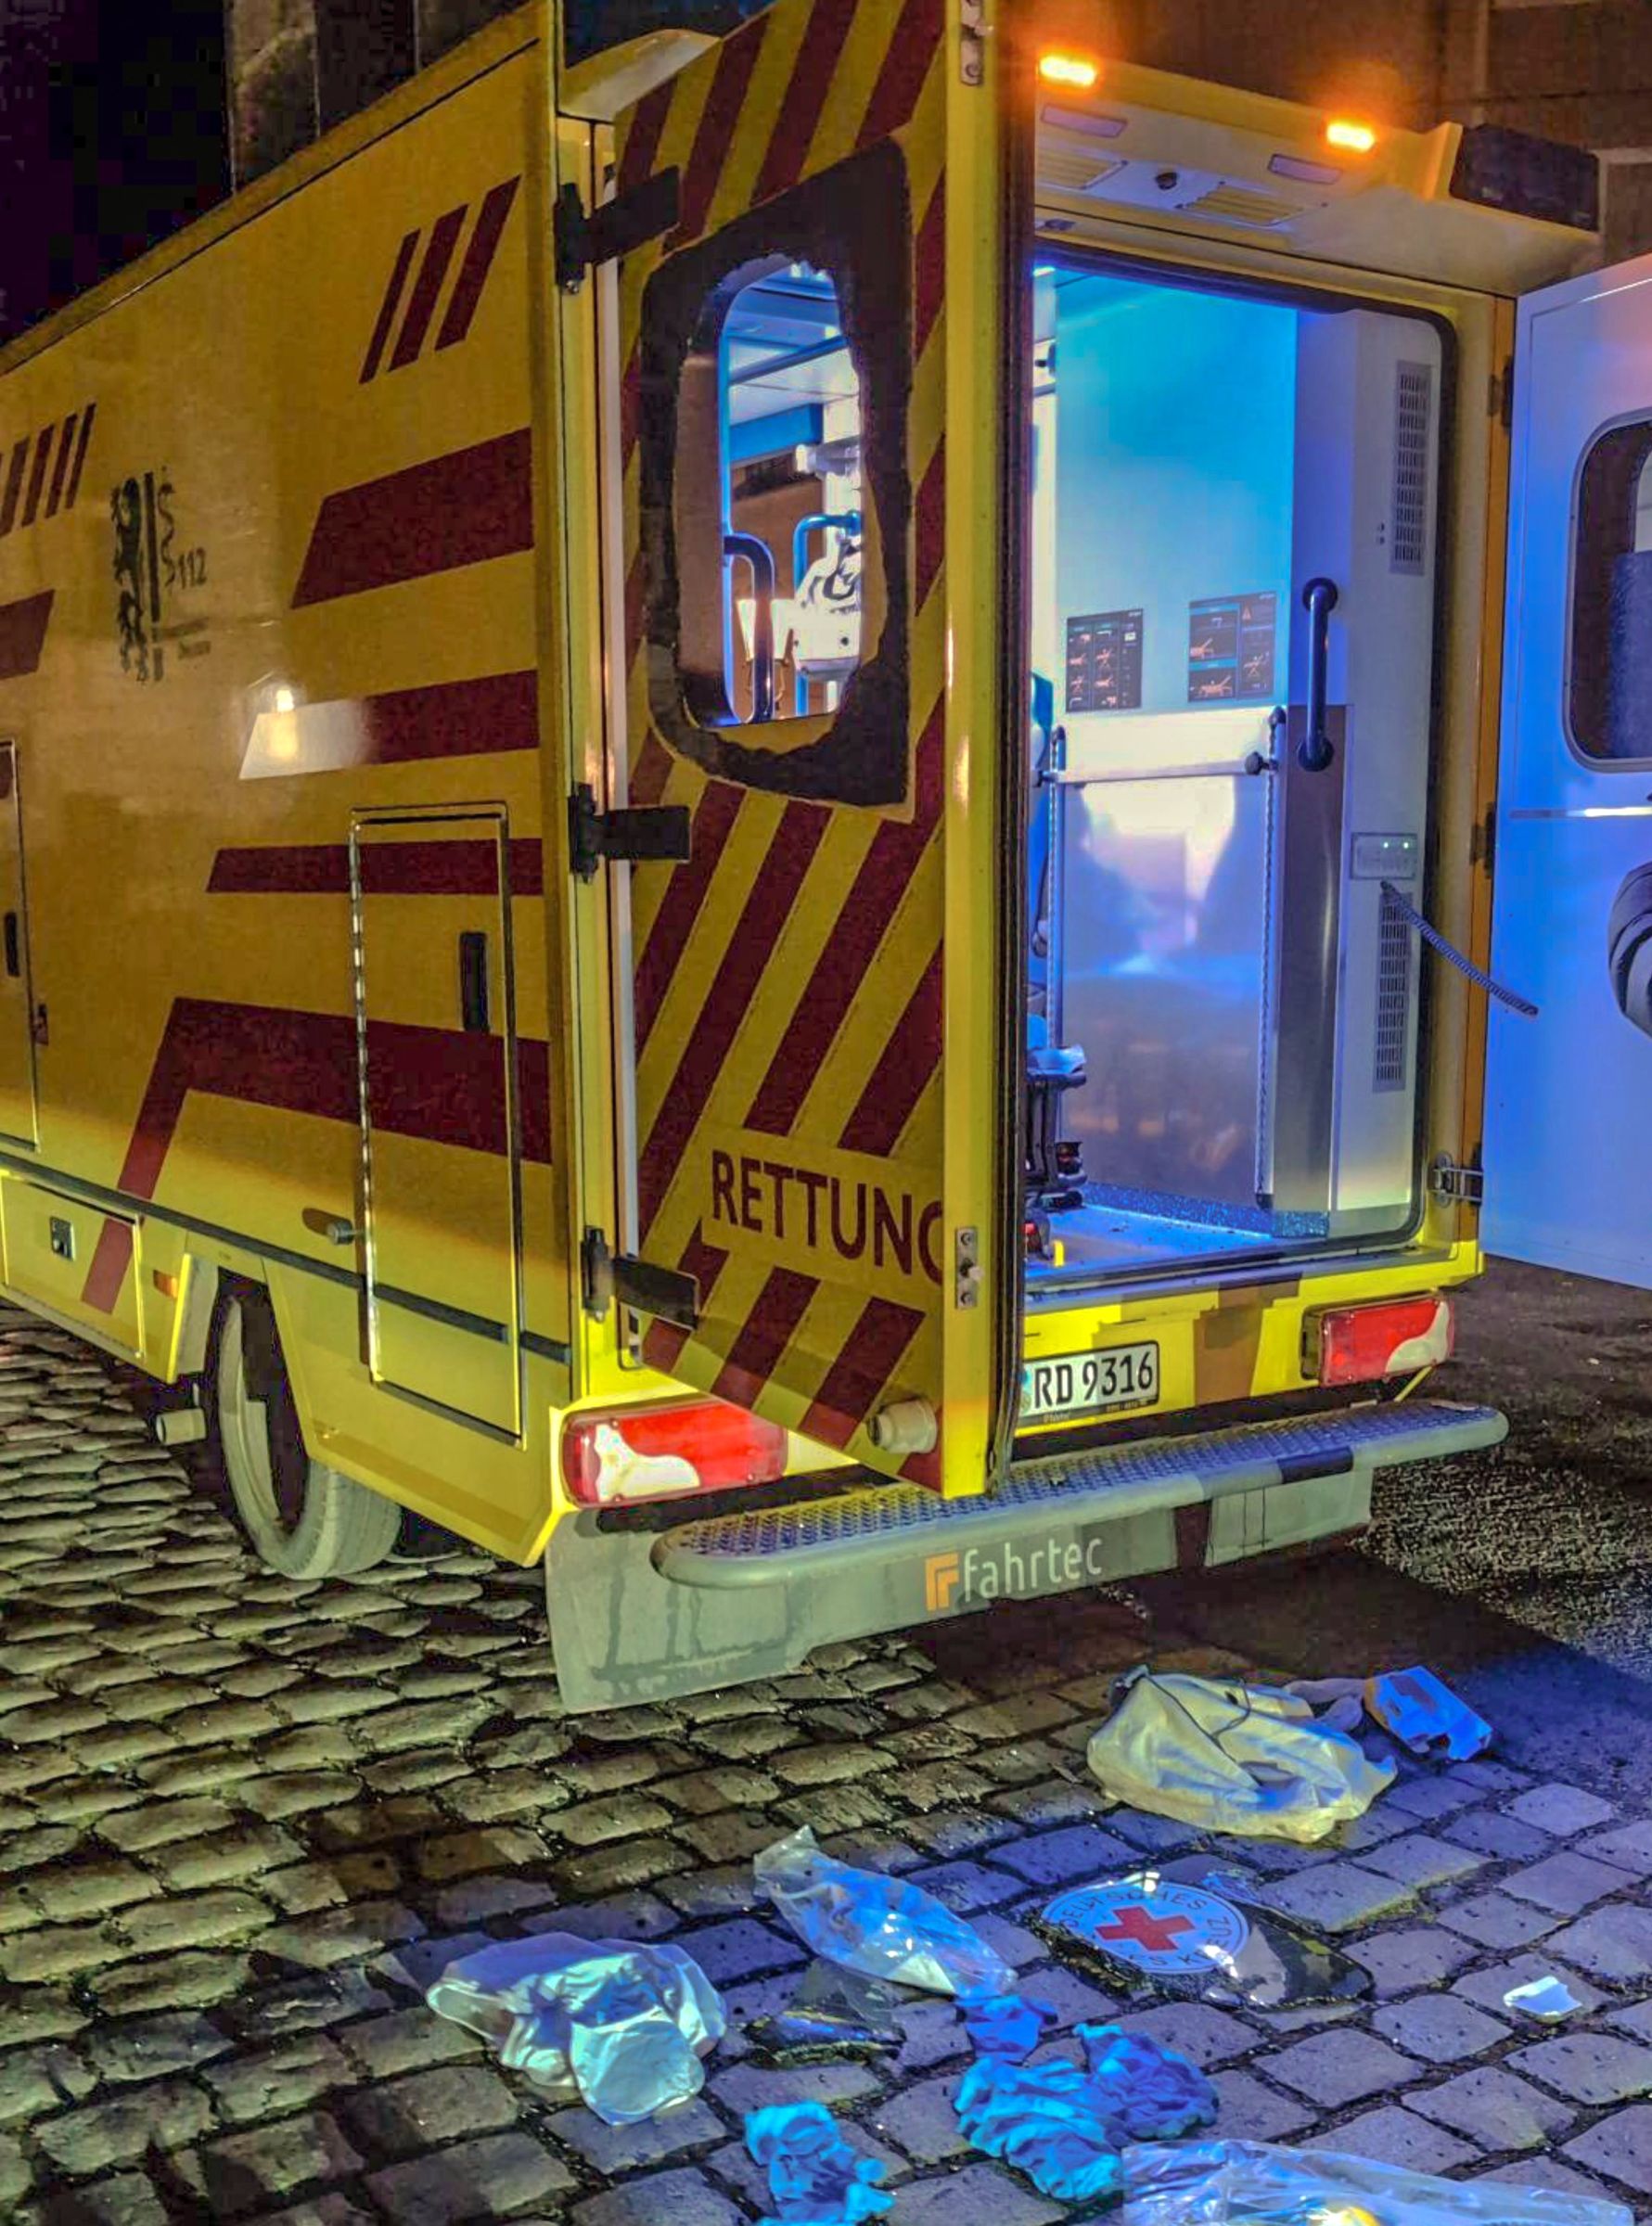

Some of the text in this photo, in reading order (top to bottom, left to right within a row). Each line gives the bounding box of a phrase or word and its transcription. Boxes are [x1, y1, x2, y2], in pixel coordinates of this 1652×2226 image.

[178, 547, 208, 590] 112
[1034, 1351, 1153, 1409] RD 9316
[963, 1538, 1102, 1603] fahrtec
